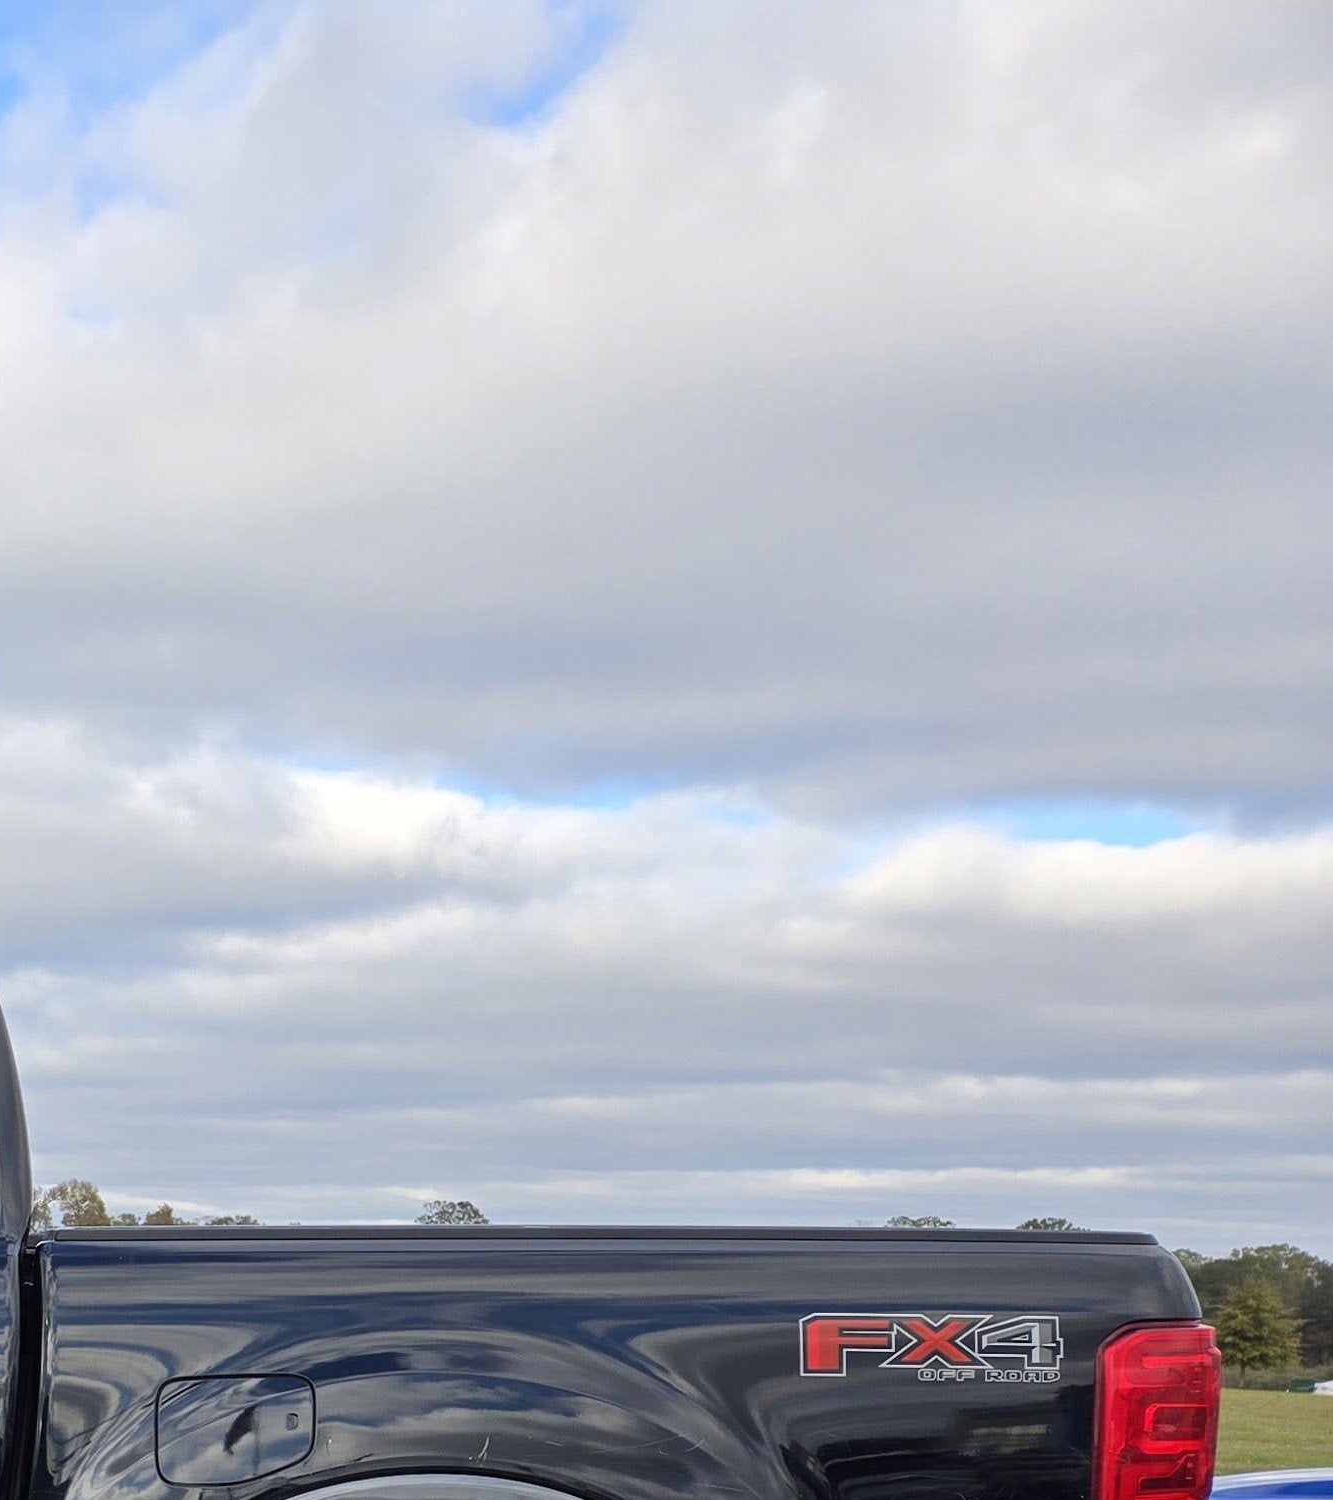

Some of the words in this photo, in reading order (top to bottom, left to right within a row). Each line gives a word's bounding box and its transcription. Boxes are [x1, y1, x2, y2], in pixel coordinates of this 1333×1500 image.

[799, 1313, 1064, 1377] FX4
[918, 1369, 975, 1382] OFF
[985, 1369, 1061, 1383] ROAD
